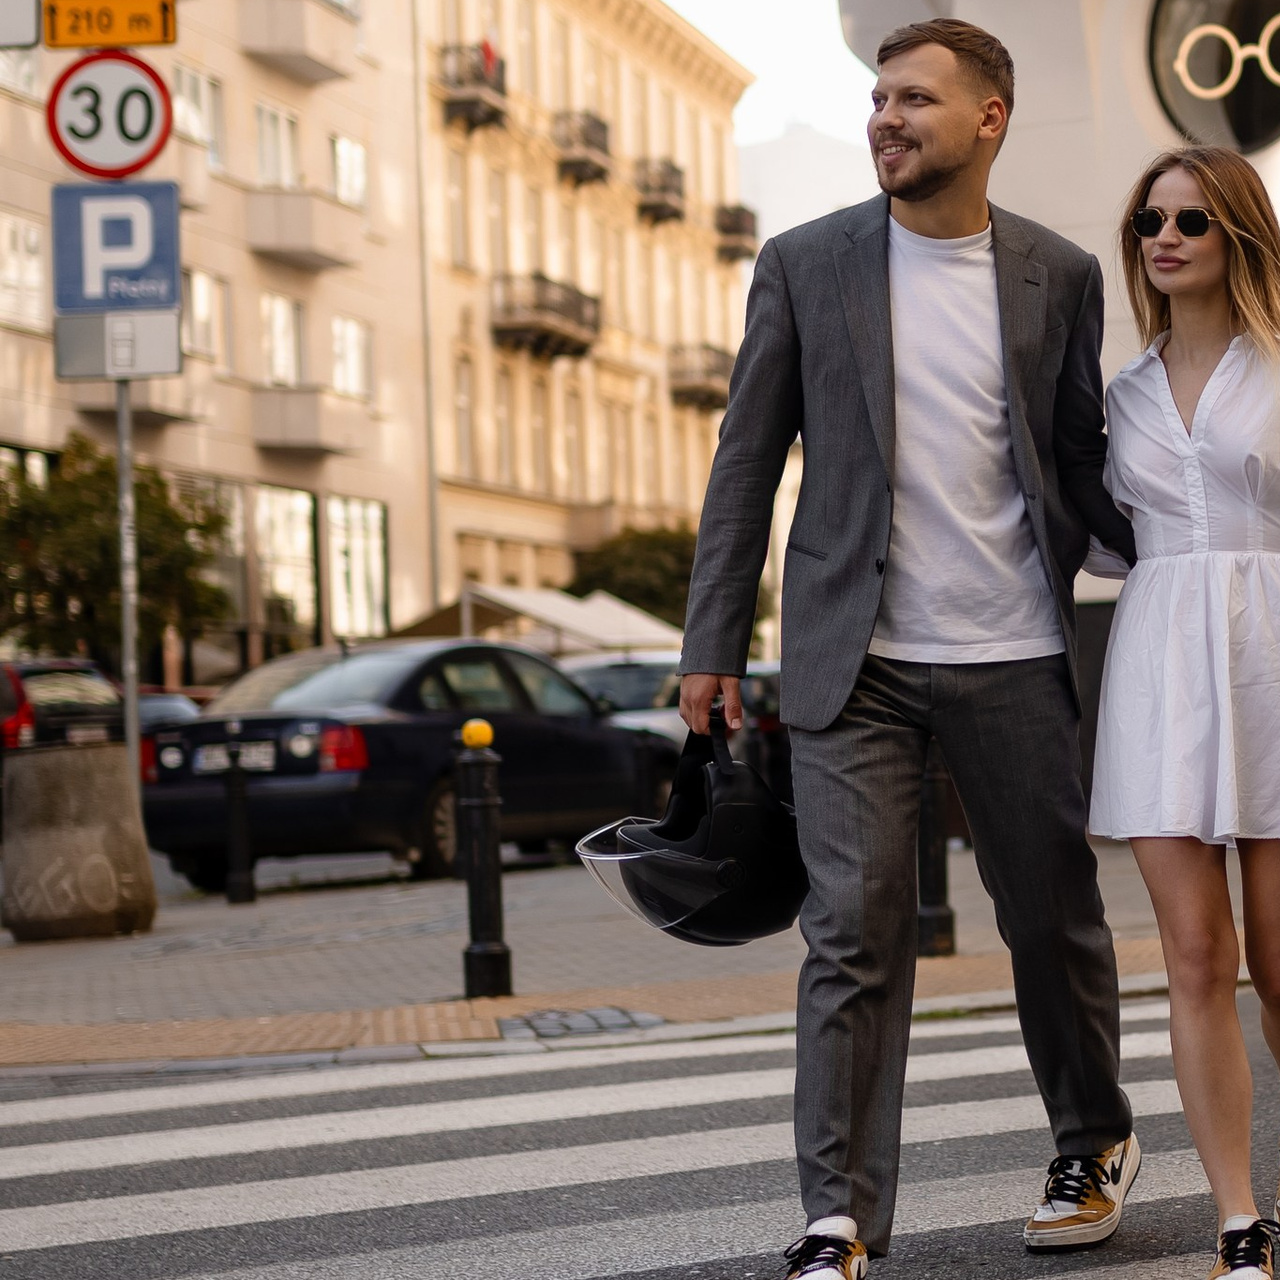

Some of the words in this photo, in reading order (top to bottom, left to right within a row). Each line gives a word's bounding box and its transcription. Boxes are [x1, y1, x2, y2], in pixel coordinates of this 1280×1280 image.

[68, 7, 113, 35] 210
[128, 13, 151, 34] m
[67, 85, 154, 142] 30
[81, 194, 153, 300] P
